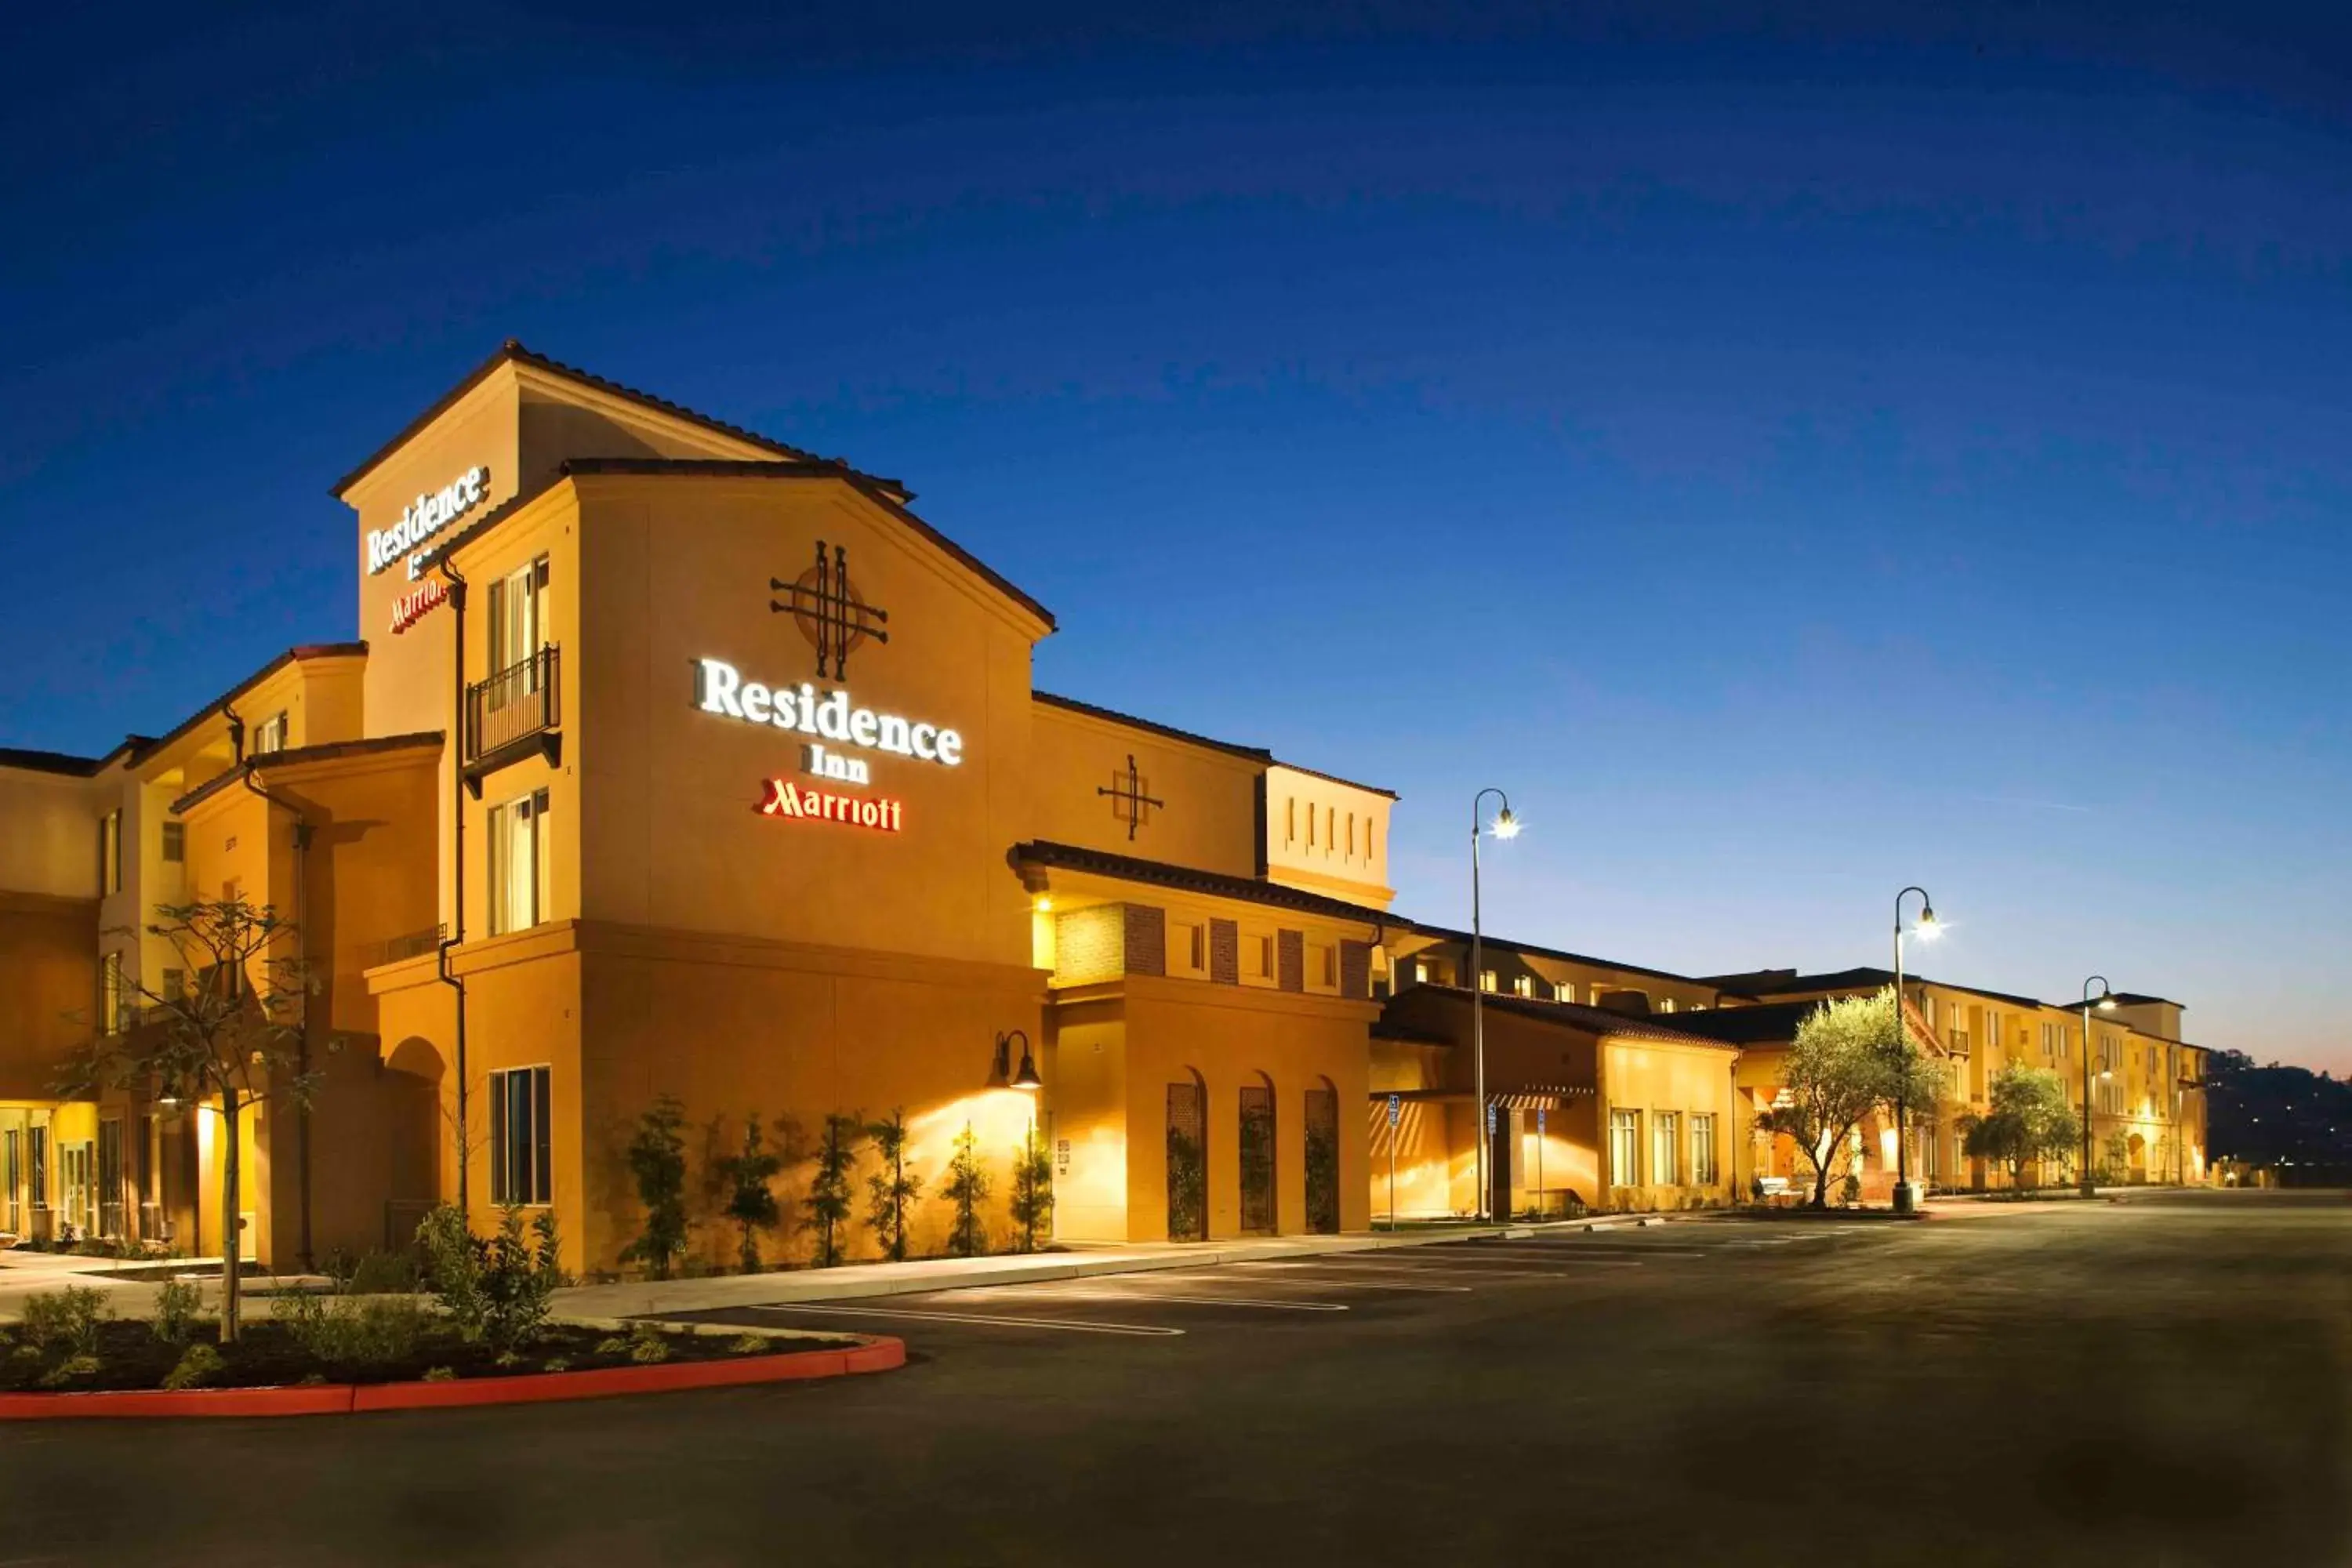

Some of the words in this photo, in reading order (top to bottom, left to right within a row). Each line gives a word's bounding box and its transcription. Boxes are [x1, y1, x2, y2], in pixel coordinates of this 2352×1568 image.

[367, 466, 482, 576] Residence
[388, 579, 447, 633] Marrio
[700, 658, 963, 766] Residence
[810, 743, 870, 785] Inn
[763, 778, 902, 831] Marriott
